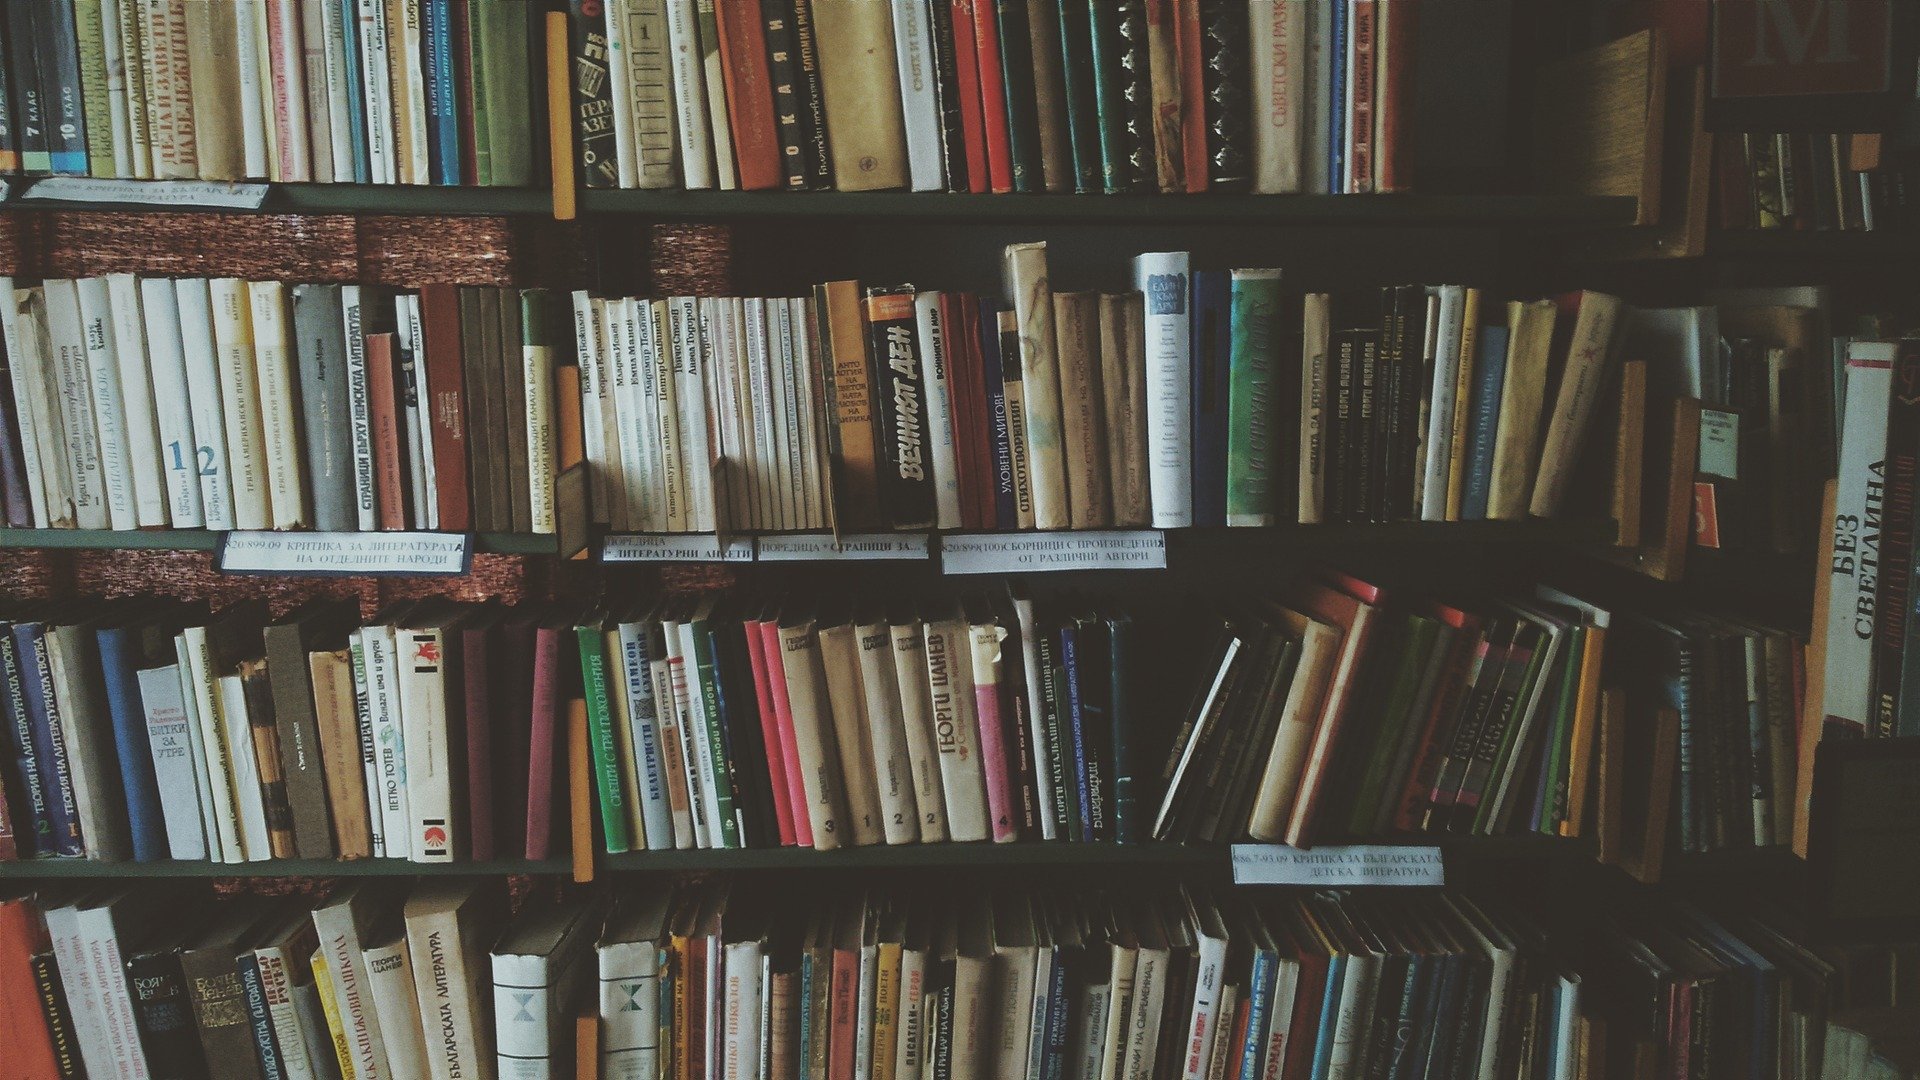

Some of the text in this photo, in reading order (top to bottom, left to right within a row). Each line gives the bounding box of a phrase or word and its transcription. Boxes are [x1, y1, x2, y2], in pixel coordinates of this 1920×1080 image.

[152, 14, 169, 89] ЗАВЕТИ
[27, 127, 39, 136] 7
[60, 124, 76, 140] 10
[683, 302, 695, 344] Тодоров
[929, 308, 939, 326] МИР
[610, 323, 625, 386] Младен Исаев
[625, 319, 639, 385] Емил Манов
[232, 348, 244, 394] ПИСАТЕЛИ
[642, 349, 654, 397] Владимир
[347, 305, 372, 510] СТРАНИЦИ ВЪРХУ НЕМСКАТА ЛИТЕРАТУРА
[887, 325, 925, 481] ВЕЧНИЯТ ДЕН
[237, 397, 252, 460] АМЕРИКАНСКИ
[993, 393, 1012, 493] УЛОВЕНИ МИГОВЕ
[168, 441, 187, 470] 1
[196, 445, 218, 476] 2
[287, 540, 463, 550] КРИТИКА ЗА ЛИТЕРАТУРАТА
[297, 552, 447, 563] НА ОТДЕЛНИТЕ НАРОДИ
[1018, 550, 1149, 561] ОТ РАЗЛИЧНИ АВТОРИ
[1831, 513, 1859, 577] БЕЗ
[1854, 458, 1885, 640] СВЕТЛИНА
[371, 640, 385, 664] други
[377, 674, 386, 690] има
[928, 635, 956, 753] ГЕОРГИ ЦАНЕВ
[378, 692, 389, 722] Винаги
[1, 635, 45, 814] ТЕОРИЯ НА ЛИТЕРАТУРНАТА ТВОРБА
[33, 637, 75, 815] ТЕОРИЯ НА ЛИТЕРАТУРНАТА ТВОРБА
[590, 654, 622, 807] СРЕЩИ С ТРИ ПОКОЛЕНИЯ
[157, 747, 185, 758] УТРЕ
[163, 737, 176, 746] ЗА
[383, 748, 395, 777] ТОТЕВ
[386, 780, 399, 811] ПЕТКО
[1055, 786, 1067, 824] ГЕОРГИ
[894, 813, 903, 824] 2
[927, 813, 935, 824] 2
[1293, 853, 1344, 862] КРИТИКА
[1348, 853, 1361, 862] ЗА
[1360, 866, 1430, 875] ЛИТЕРАТУРА
[428, 932, 461, 1079] БЪЛГАРСКАТА ЛИТЕРАТУРА
